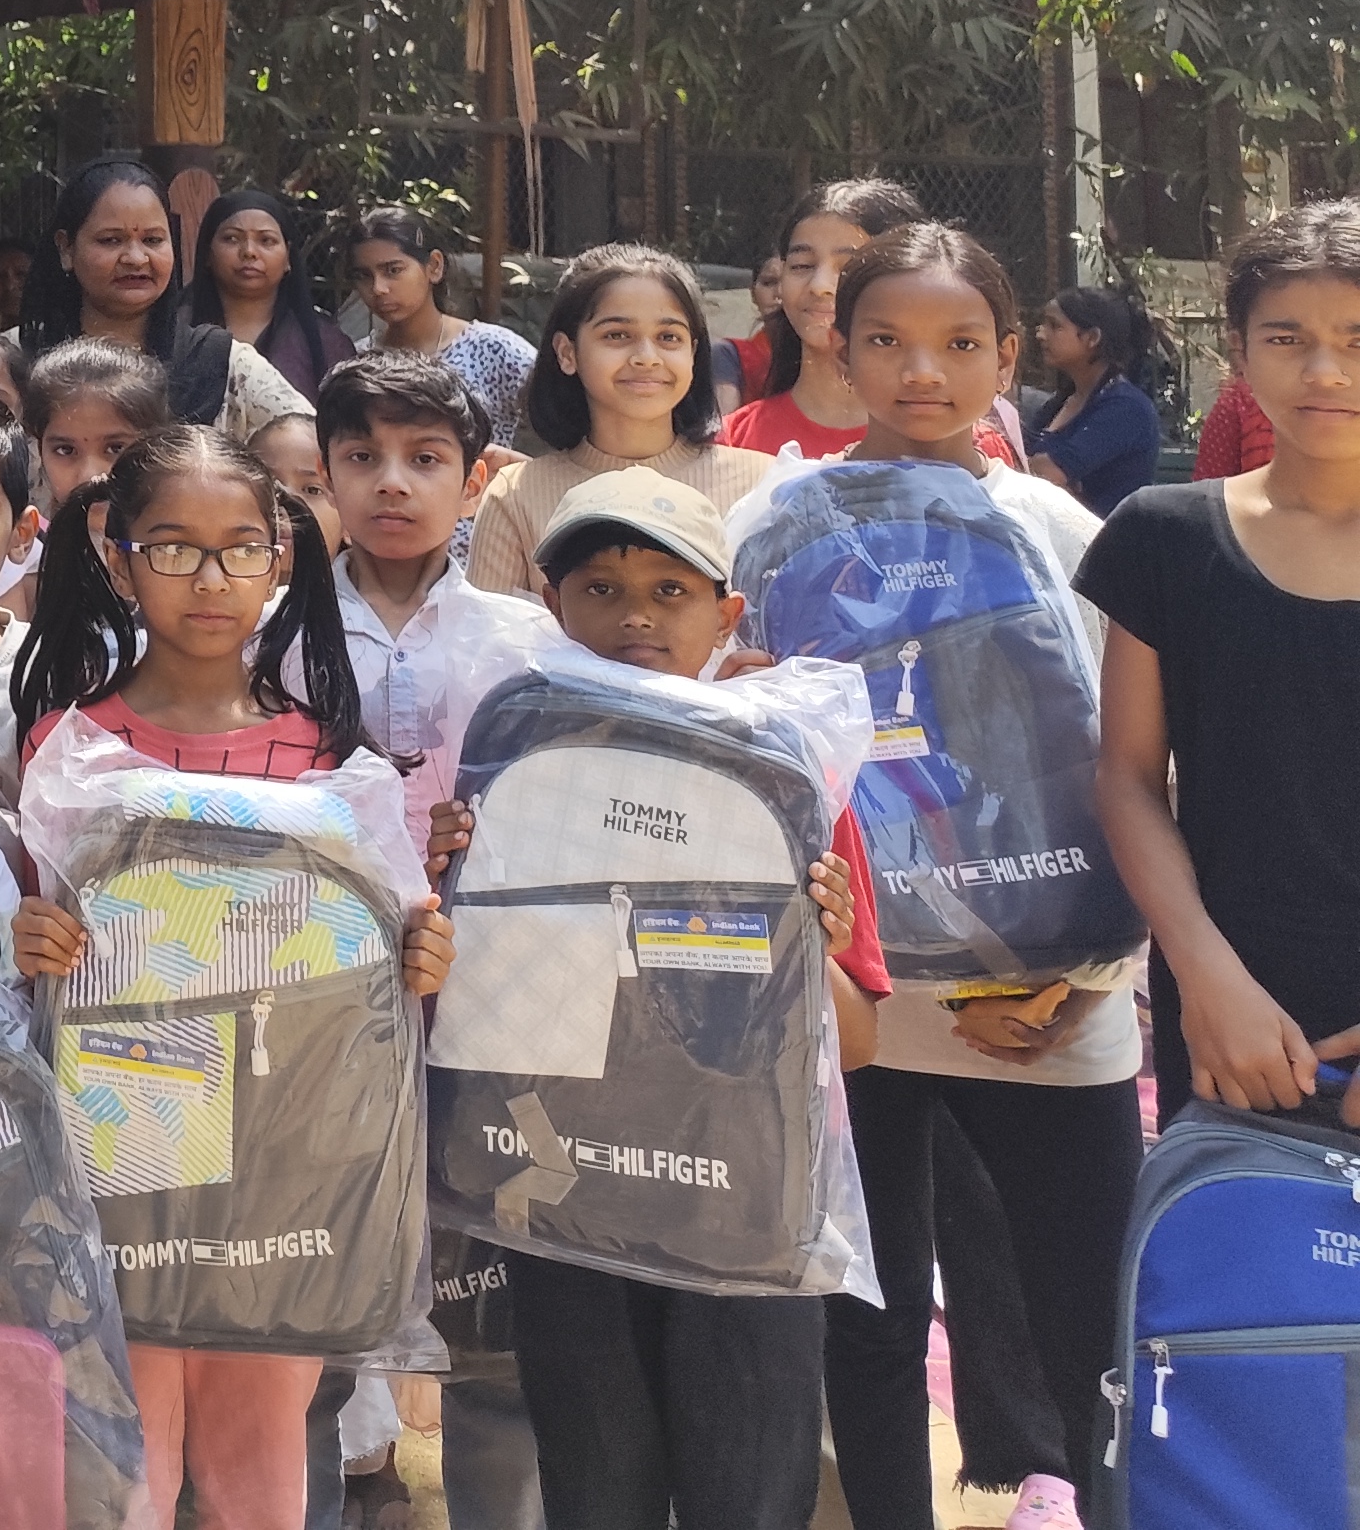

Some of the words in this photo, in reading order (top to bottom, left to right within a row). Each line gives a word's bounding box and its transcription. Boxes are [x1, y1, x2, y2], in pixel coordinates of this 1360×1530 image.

[881, 559, 947, 578] TOMMY
[882, 573, 958, 592] HILFIGER
[609, 797, 687, 827] TOMMY
[603, 814, 688, 846] HILFIGER
[990, 846, 1092, 884] HILFIGER
[223, 895, 298, 917] TOMMY
[613, 1146, 732, 1190] HILFIGER
[105, 1239, 189, 1270] TOMMY
[227, 1228, 335, 1267] HILFIGER
[1314, 1227, 1360, 1250] TOM
[1312, 1244, 1360, 1267] HILF
[434, 1262, 508, 1301] HILFIG
